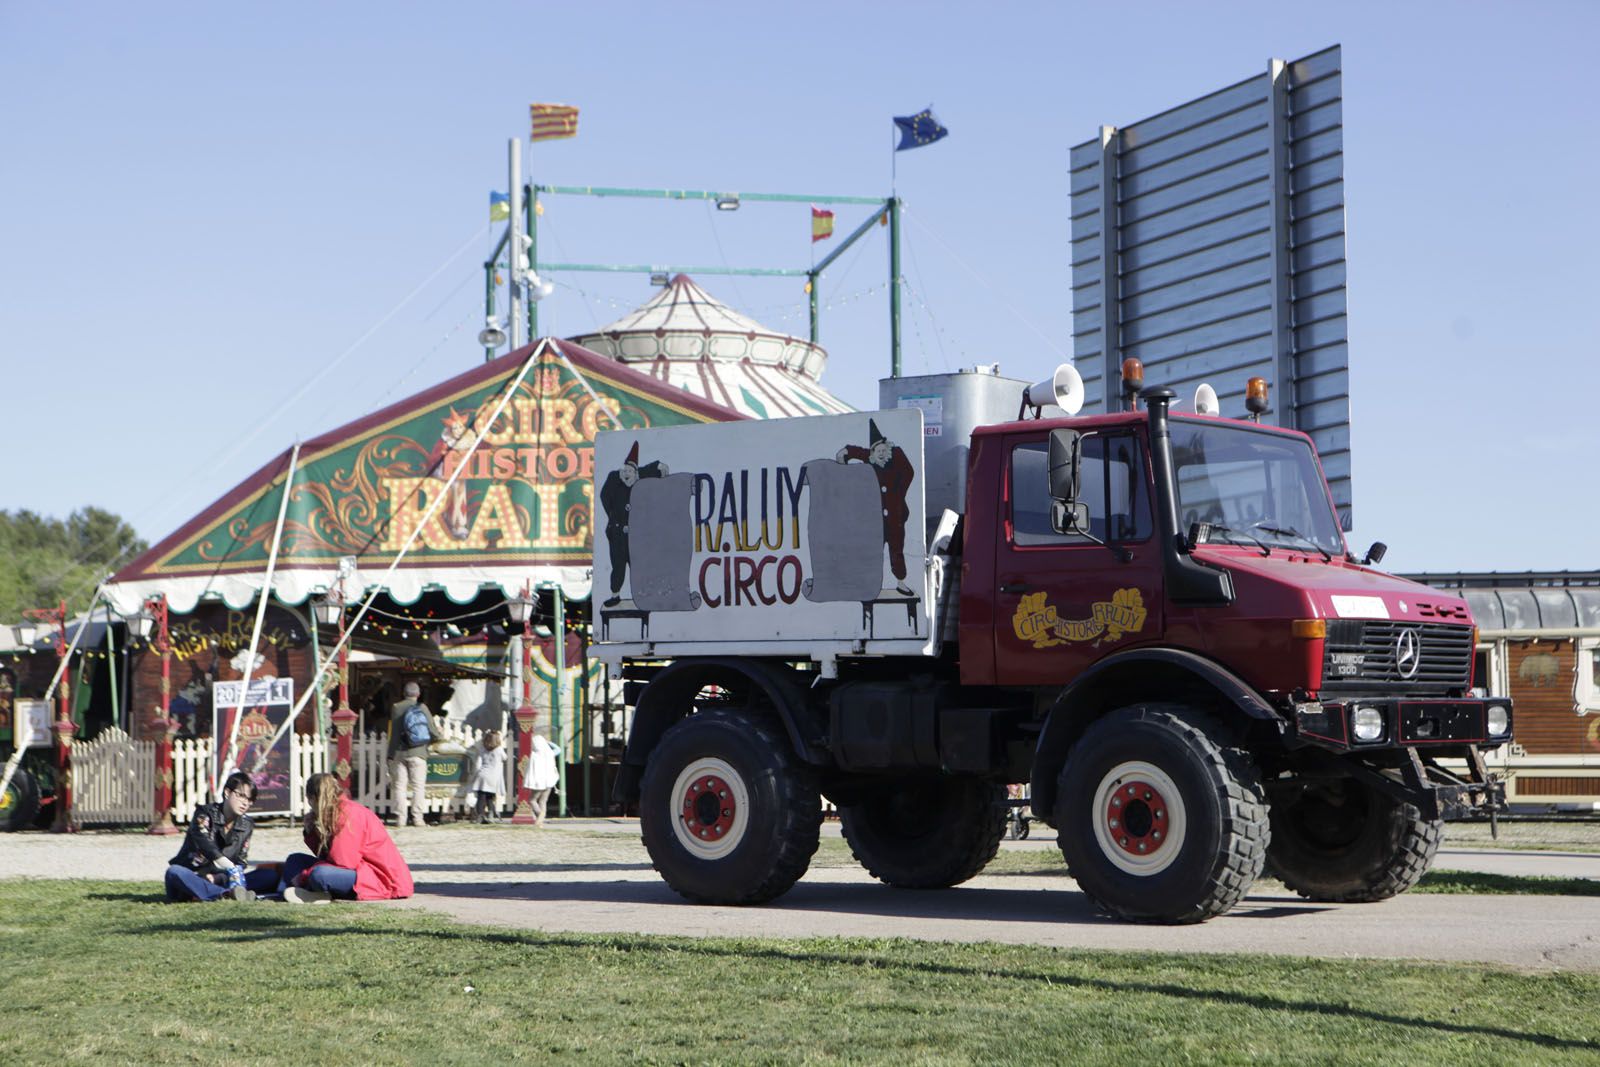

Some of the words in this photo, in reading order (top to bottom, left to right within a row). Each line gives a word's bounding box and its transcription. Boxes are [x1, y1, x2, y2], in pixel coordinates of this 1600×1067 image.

[380, 477, 595, 551] RAL
[694, 466, 808, 553] RALUY
[700, 555, 803, 609] CIRCO
[1019, 607, 1056, 636] CIRC
[1094, 603, 1140, 630] RALUY
